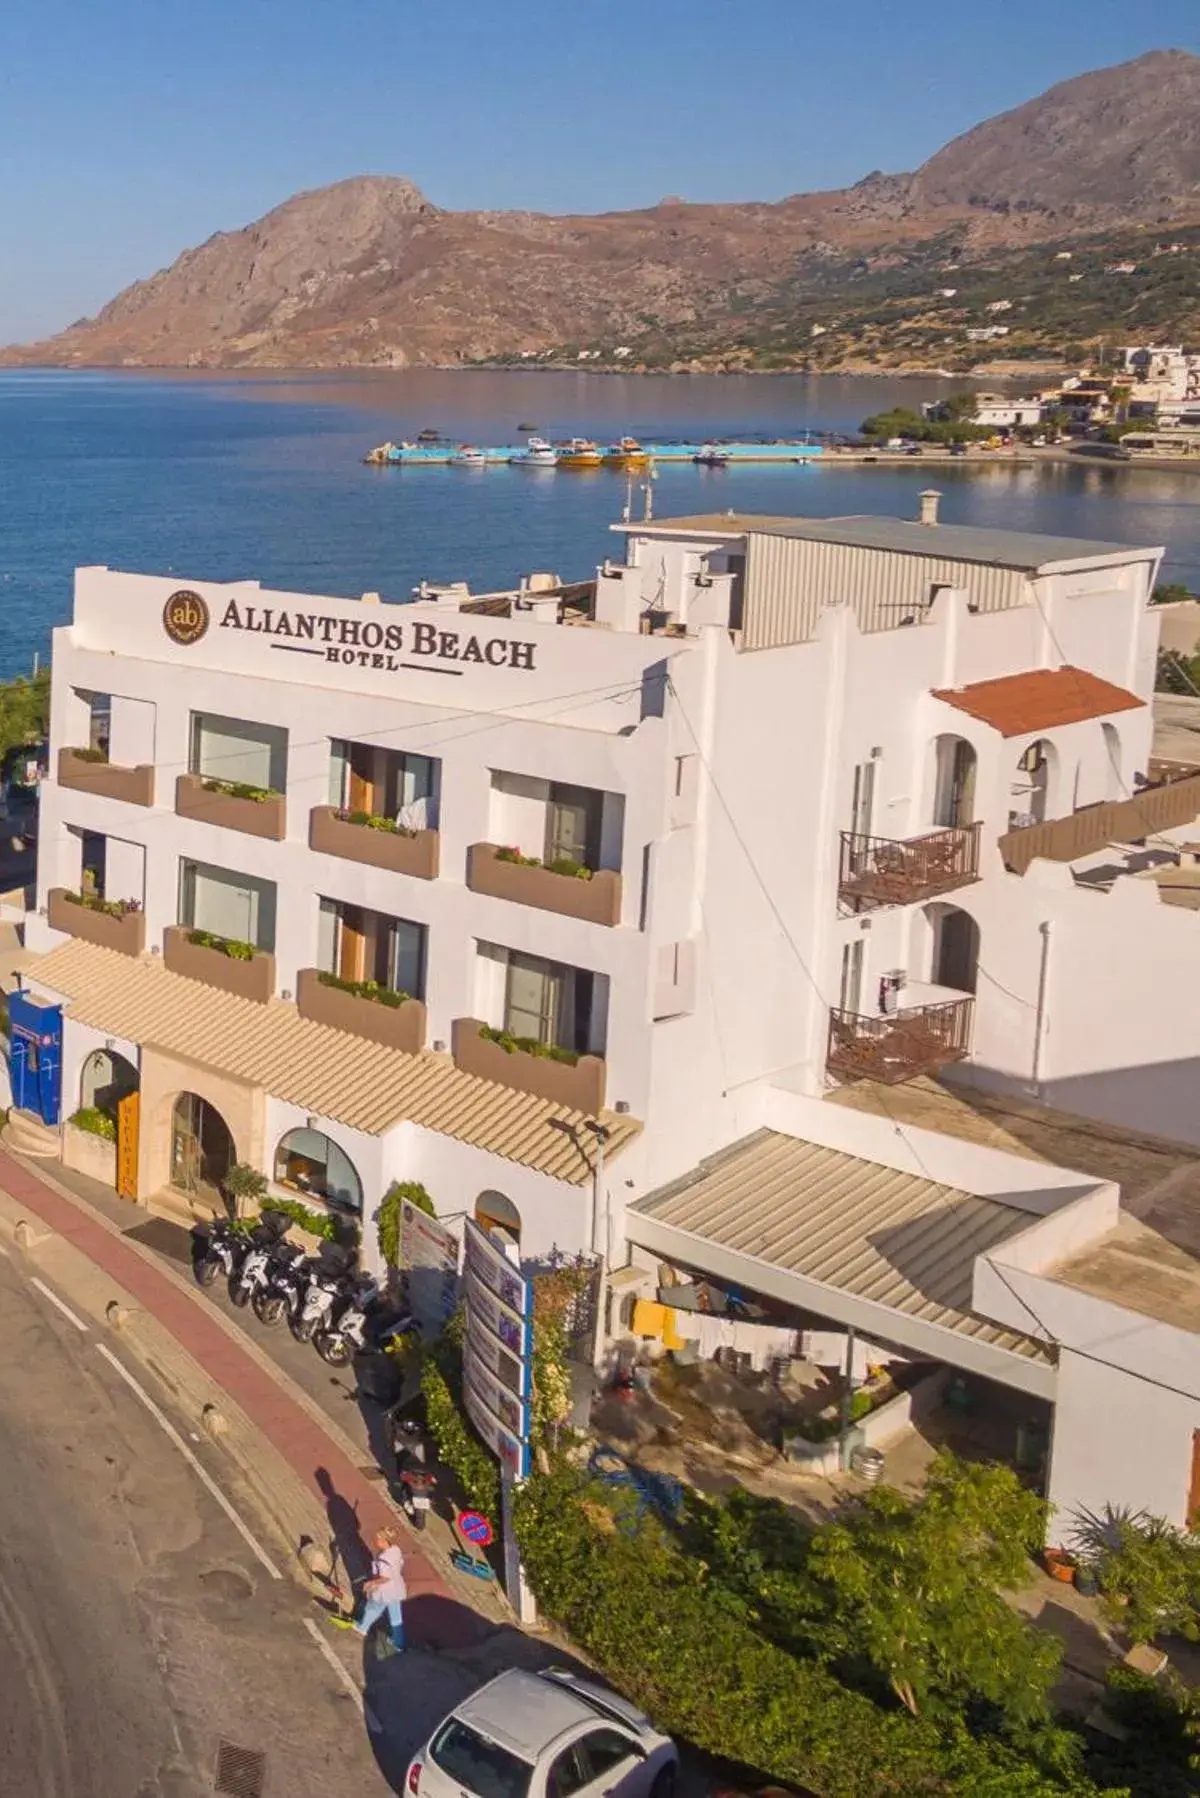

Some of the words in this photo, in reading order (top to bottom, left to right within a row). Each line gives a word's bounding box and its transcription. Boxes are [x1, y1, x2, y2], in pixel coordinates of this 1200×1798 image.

[220, 599, 402, 652] ALIANTHOS
[411, 621, 537, 671] BEACH
[325, 647, 400, 672] HOTEL
